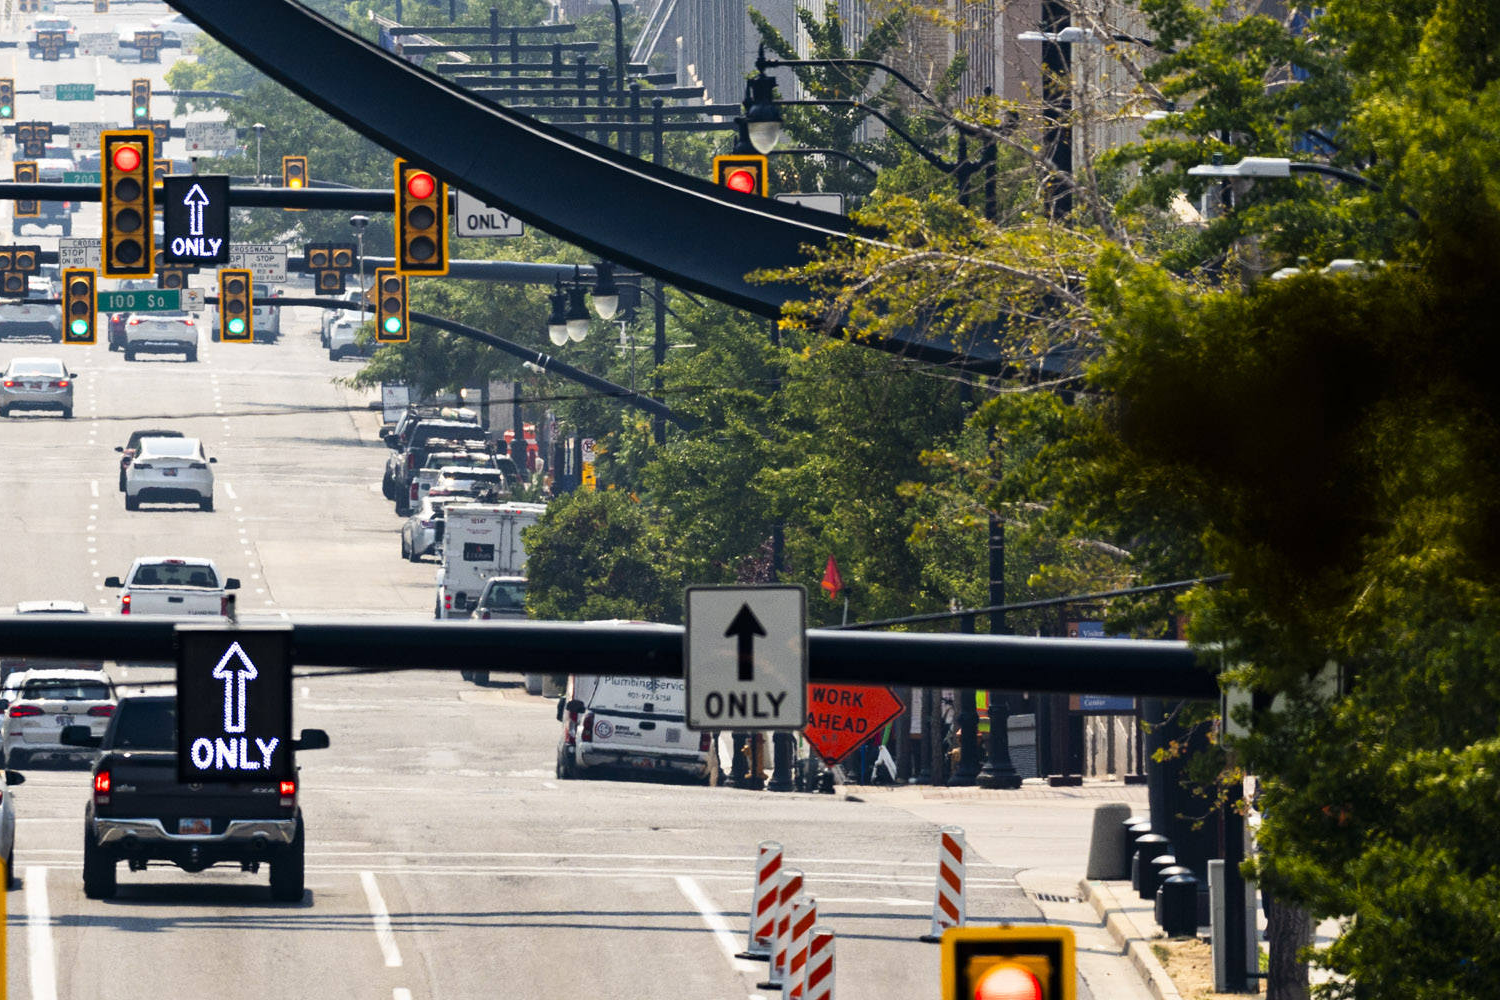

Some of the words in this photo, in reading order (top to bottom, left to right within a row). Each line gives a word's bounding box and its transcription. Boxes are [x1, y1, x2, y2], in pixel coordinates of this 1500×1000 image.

[467, 213, 511, 230] ONLY
[62, 249, 84, 257] STOP
[171, 237, 222, 257] ONLY
[109, 295, 135, 308] 100
[604, 675, 652, 690] Plumbing
[704, 690, 787, 719] ONLY
[812, 687, 864, 708] WORK
[1083, 699, 1106, 707] Center
[808, 711, 868, 734] AHEAD
[190, 737, 280, 770] ONLY
